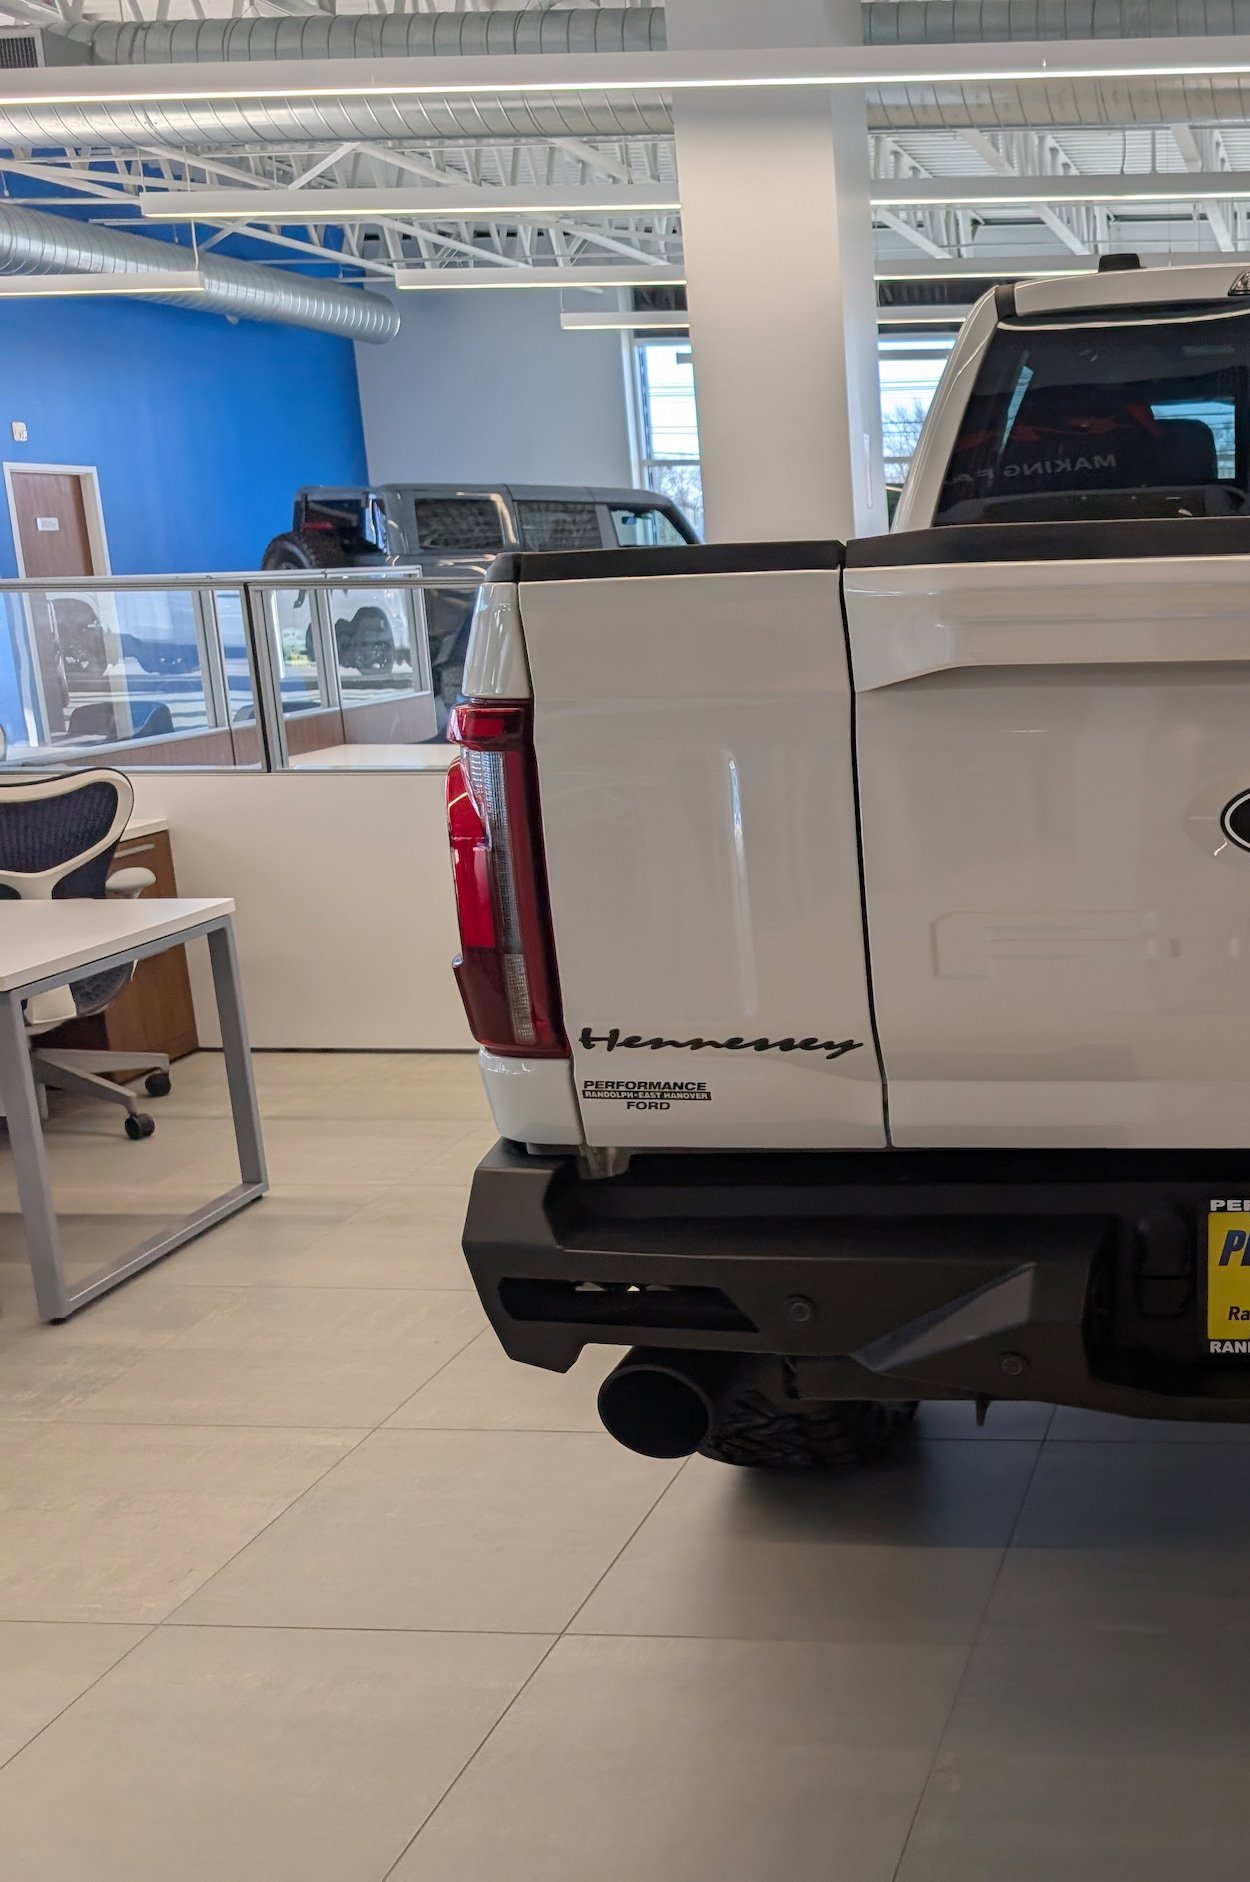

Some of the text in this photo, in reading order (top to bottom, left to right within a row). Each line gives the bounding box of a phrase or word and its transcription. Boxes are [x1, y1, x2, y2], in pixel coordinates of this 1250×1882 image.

[579, 1027, 863, 1059] Hennessey
[583, 1080, 707, 1091] PERFORMANCE
[664, 1091, 709, 1100] HANOVER
[626, 1101, 671, 1110] FORD
